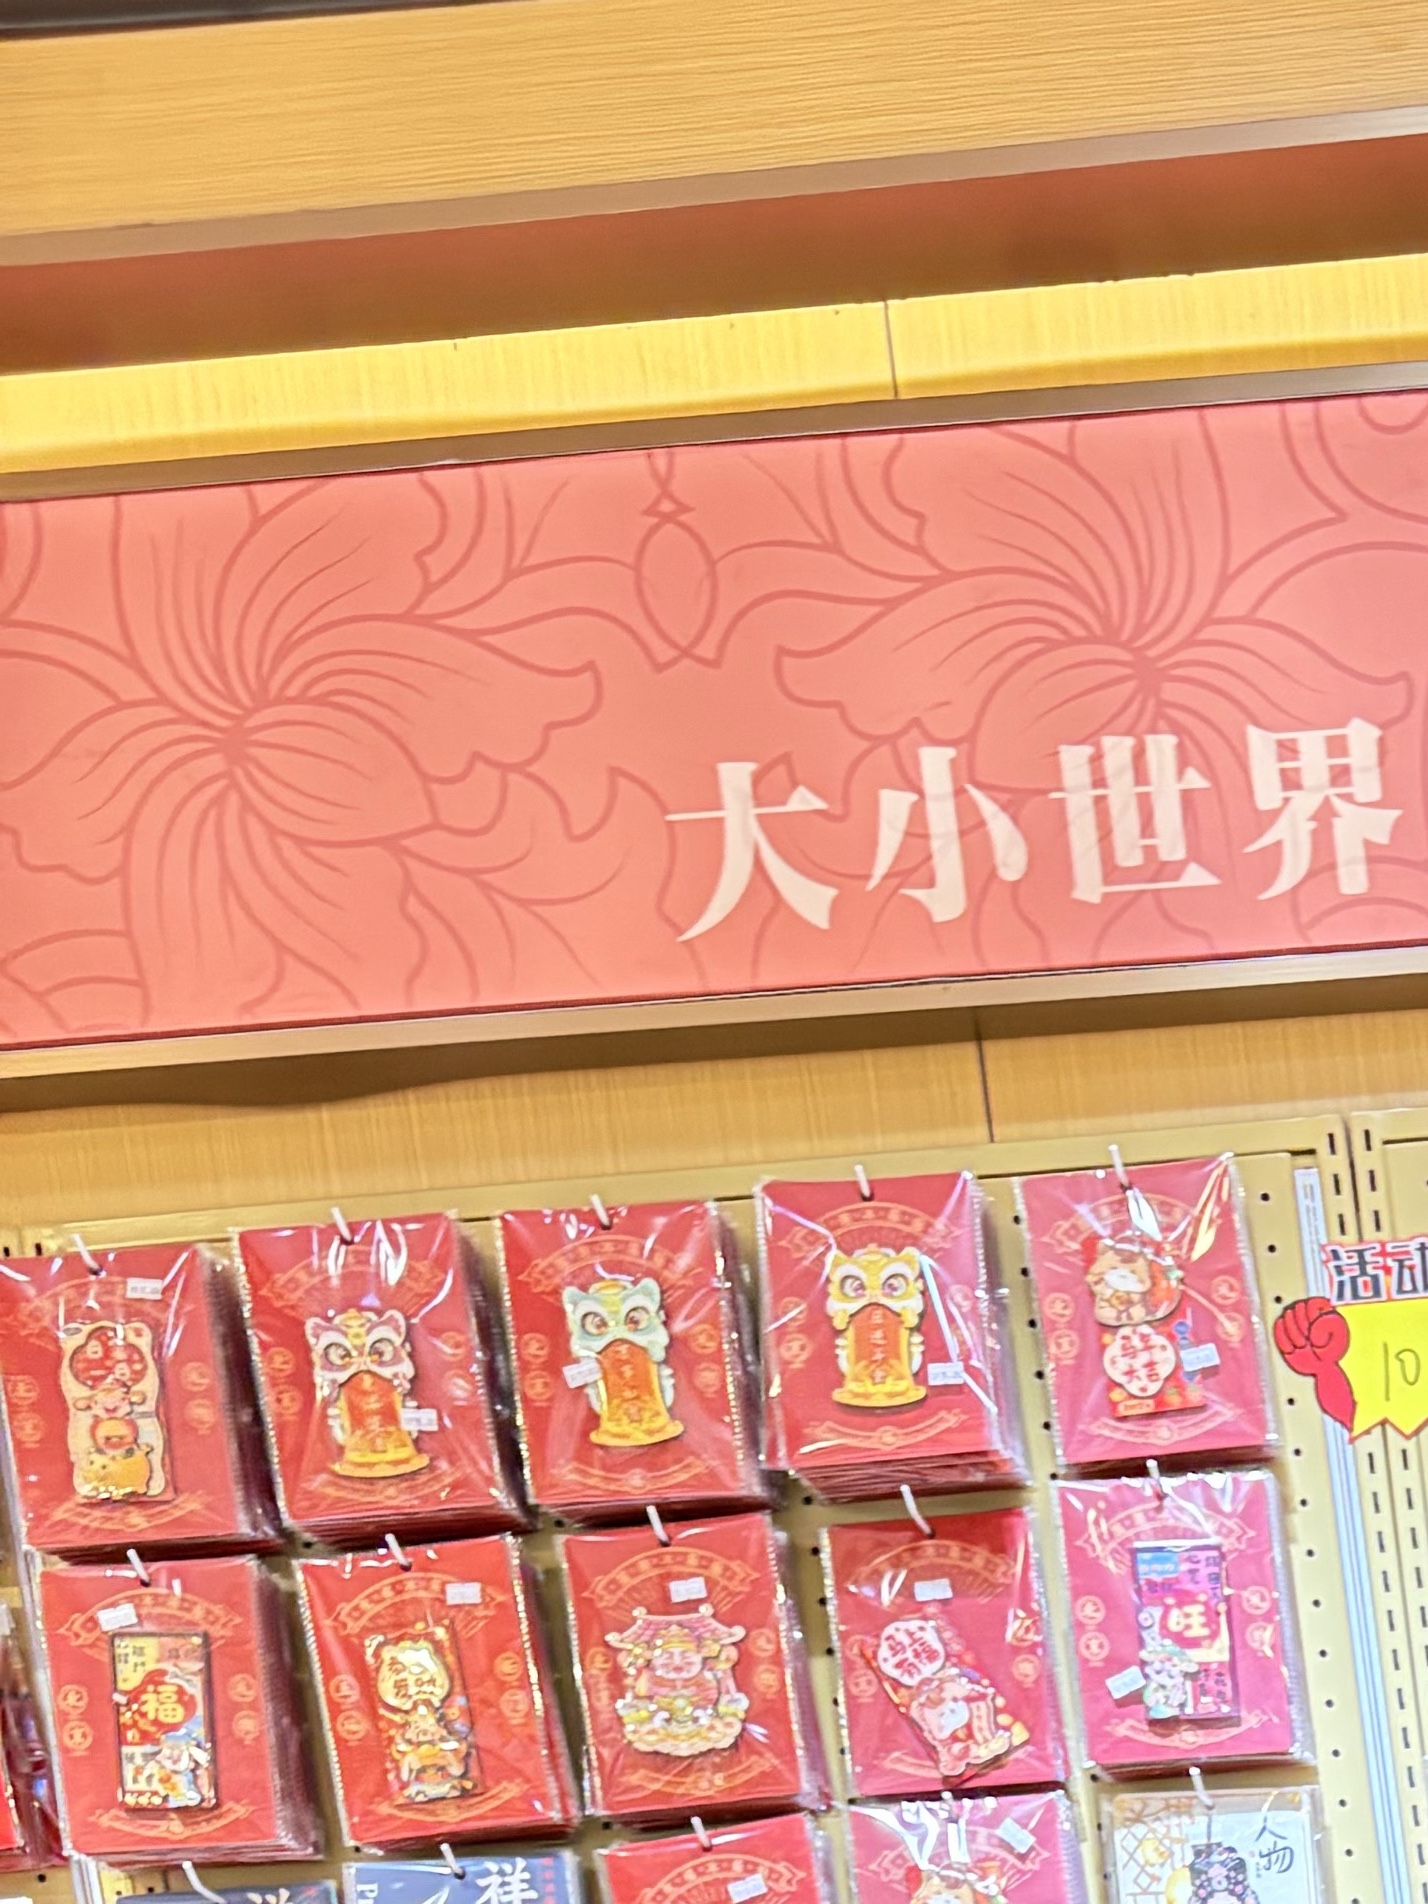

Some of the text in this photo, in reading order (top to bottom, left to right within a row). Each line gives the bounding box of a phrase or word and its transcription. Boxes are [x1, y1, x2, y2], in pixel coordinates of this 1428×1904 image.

[667, 717, 1405, 942] 大小世界
[142, 1684, 186, 1723] 福
